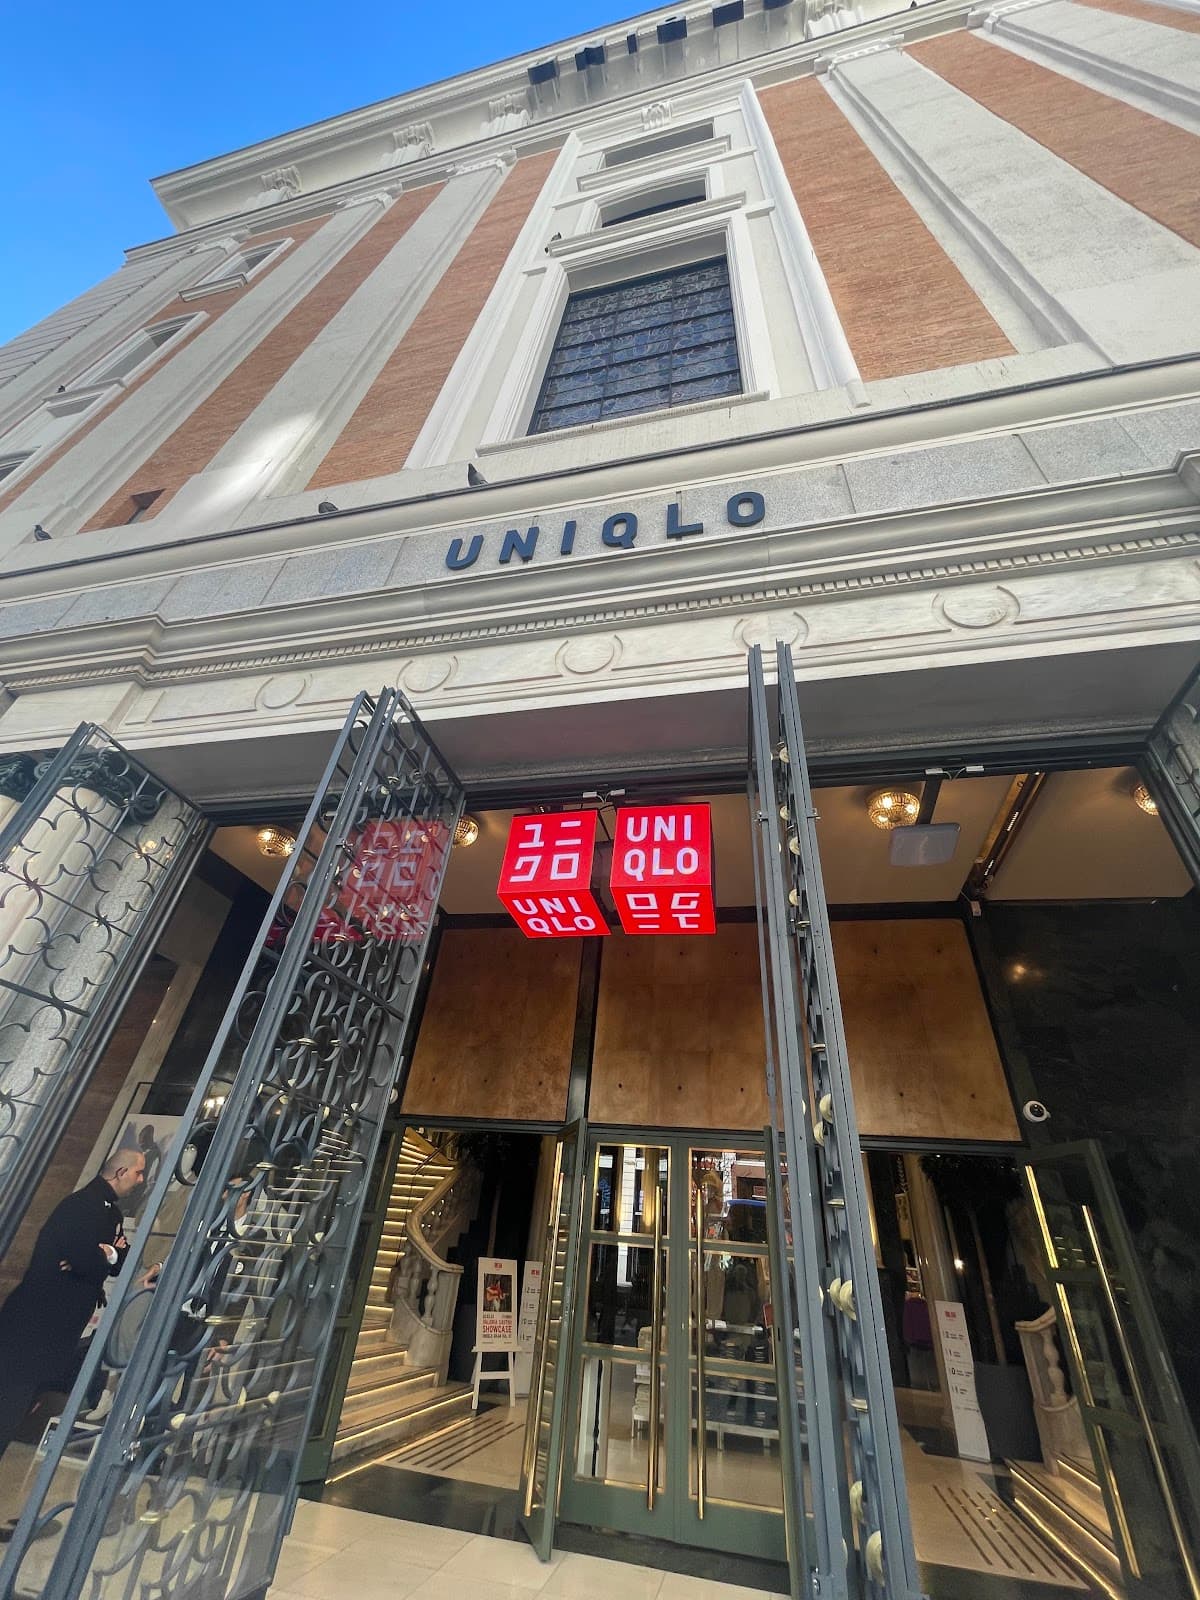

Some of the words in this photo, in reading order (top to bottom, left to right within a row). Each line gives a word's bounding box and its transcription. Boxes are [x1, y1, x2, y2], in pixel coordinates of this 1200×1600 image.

[446, 491, 765, 570] UNIQLO
[626, 815, 692, 842] UNI
[623, 847, 699, 881] QLO
[511, 896, 582, 915] UNI
[526, 915, 596, 935] QLO
[483, 1325, 512, 1333] SHOWCASE
